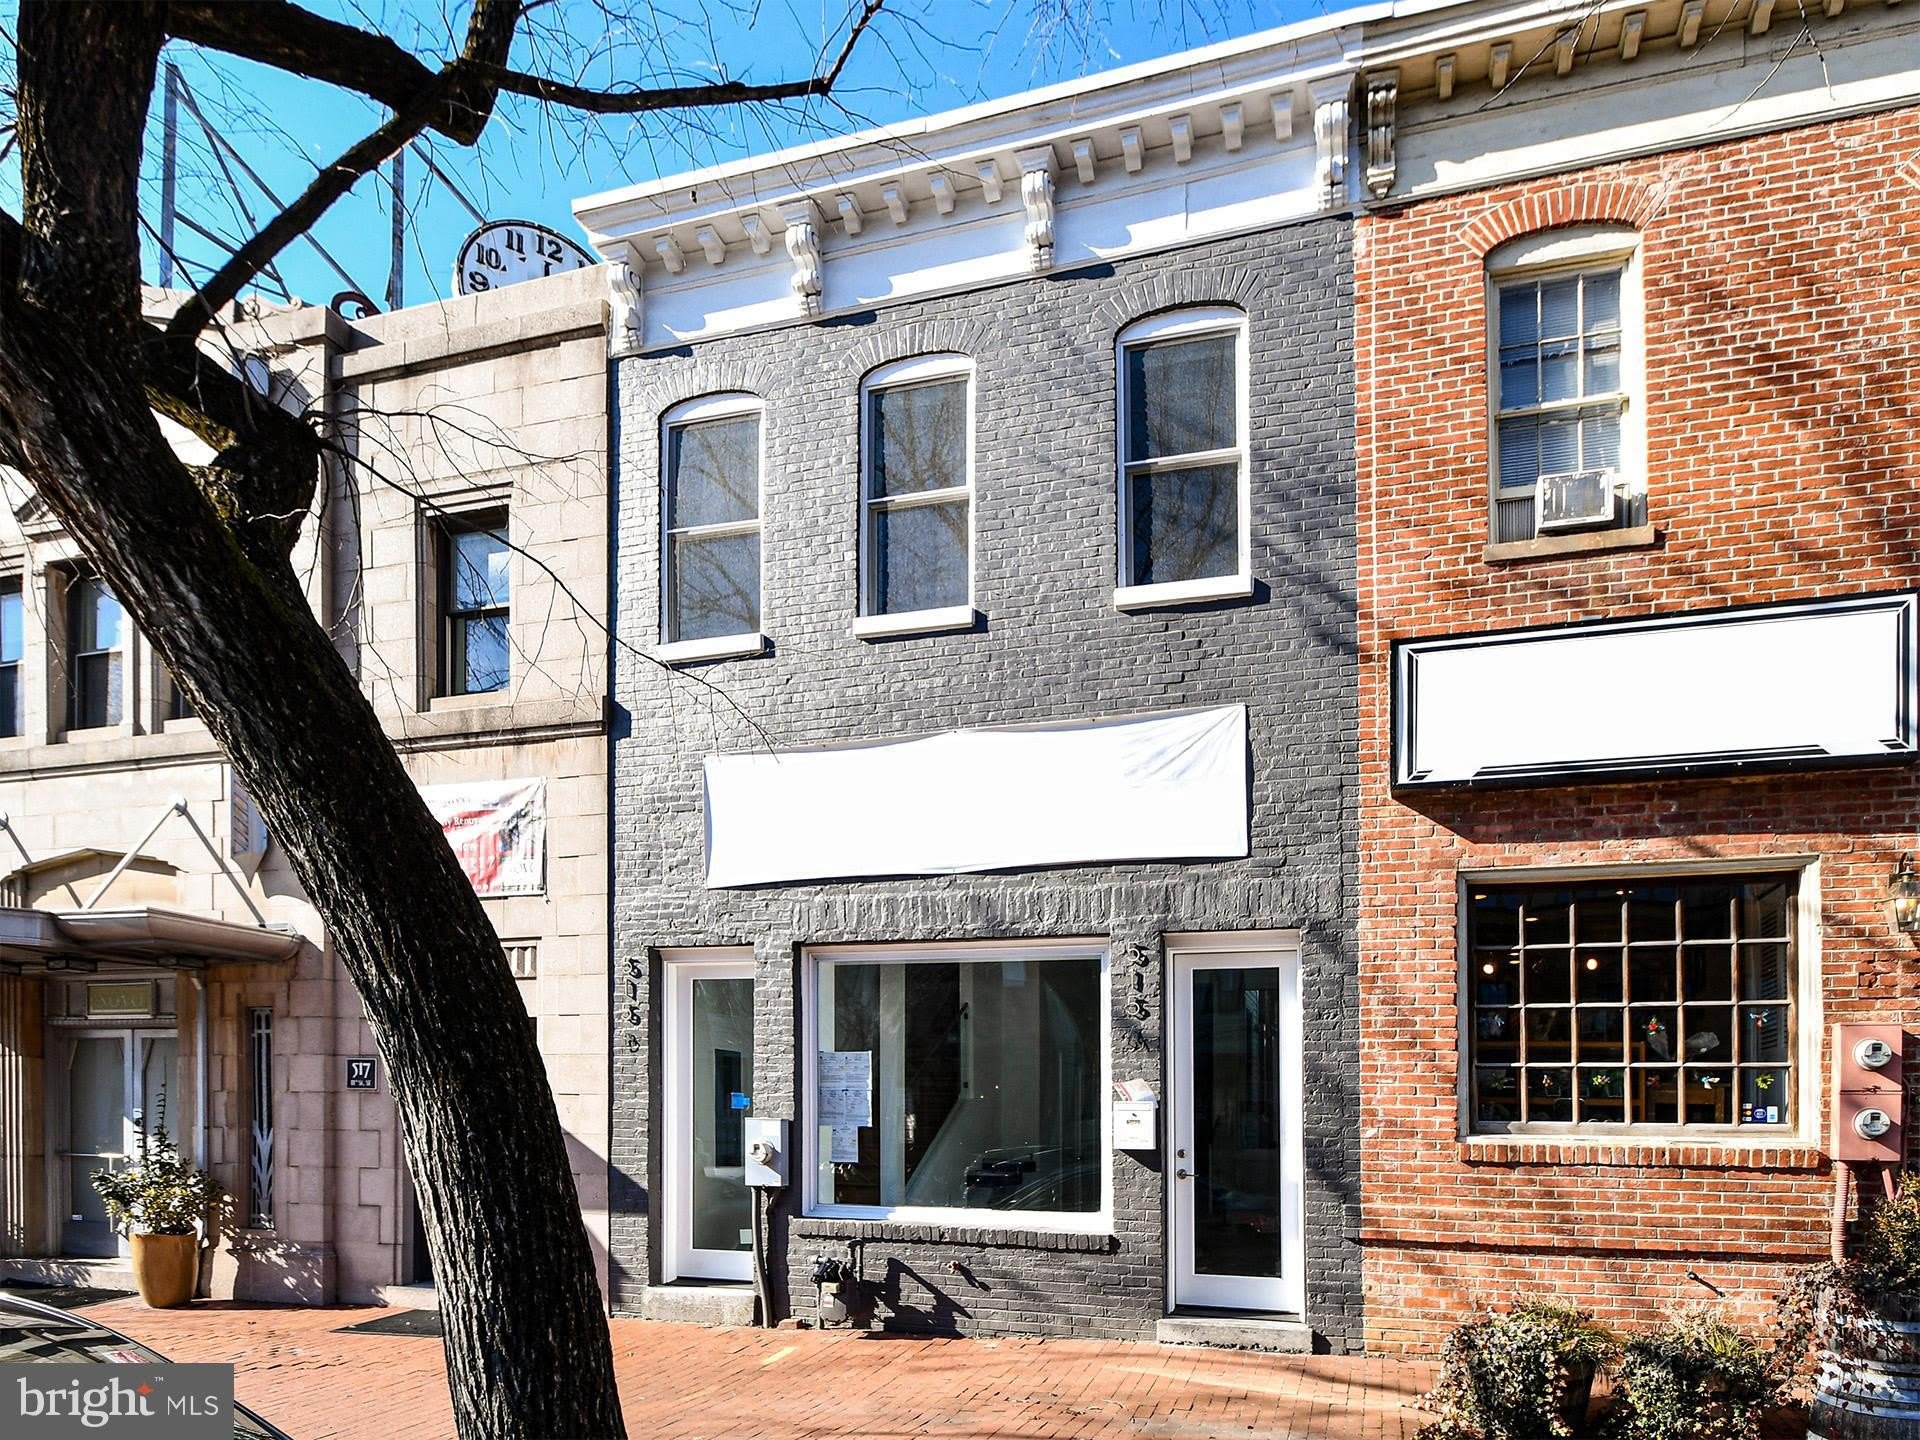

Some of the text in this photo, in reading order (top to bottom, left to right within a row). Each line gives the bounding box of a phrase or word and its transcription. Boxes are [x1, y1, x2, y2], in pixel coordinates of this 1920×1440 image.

[505, 228, 525, 255] 11
[536, 233, 564, 264] 12
[475, 242, 502, 270] 10
[468, 271, 490, 292] 9
[351, 1062, 372, 1079] 517
